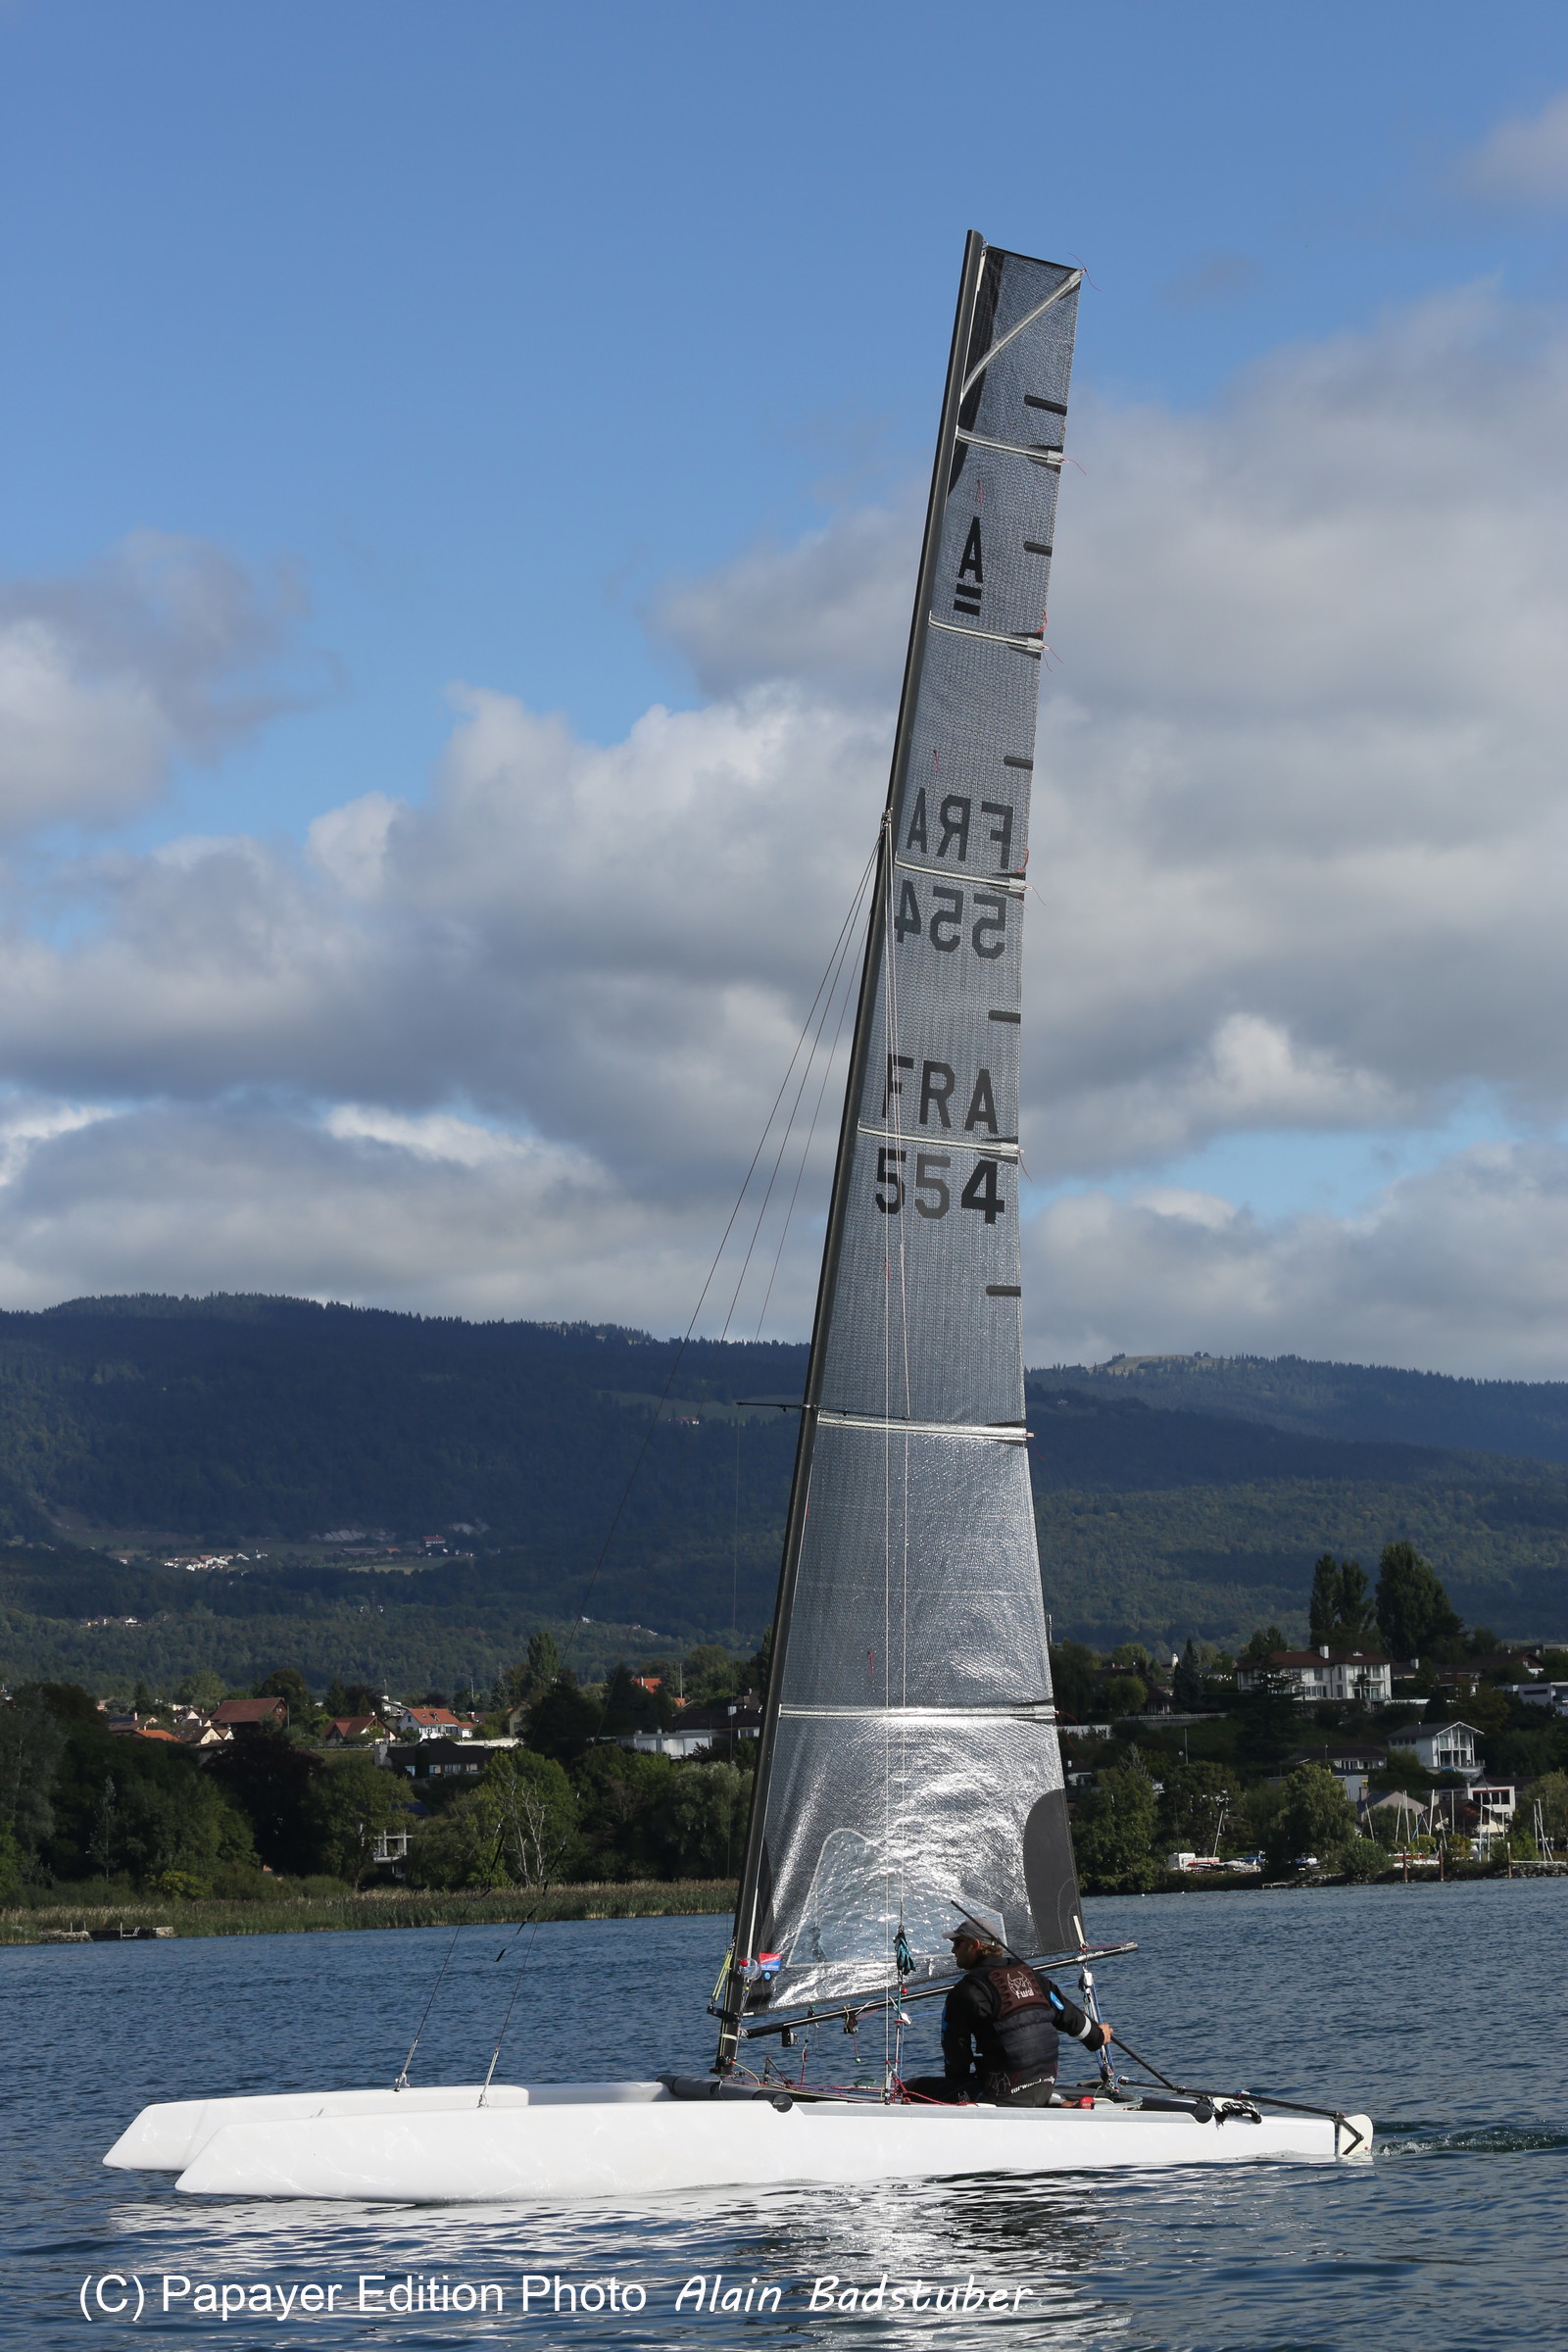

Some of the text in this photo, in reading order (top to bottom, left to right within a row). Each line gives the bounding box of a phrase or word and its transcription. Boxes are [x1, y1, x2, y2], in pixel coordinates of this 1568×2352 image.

[957, 515, 984, 584] A
[882, 1054, 1000, 1135] FRA
[875, 1148, 1005, 1225] 554
